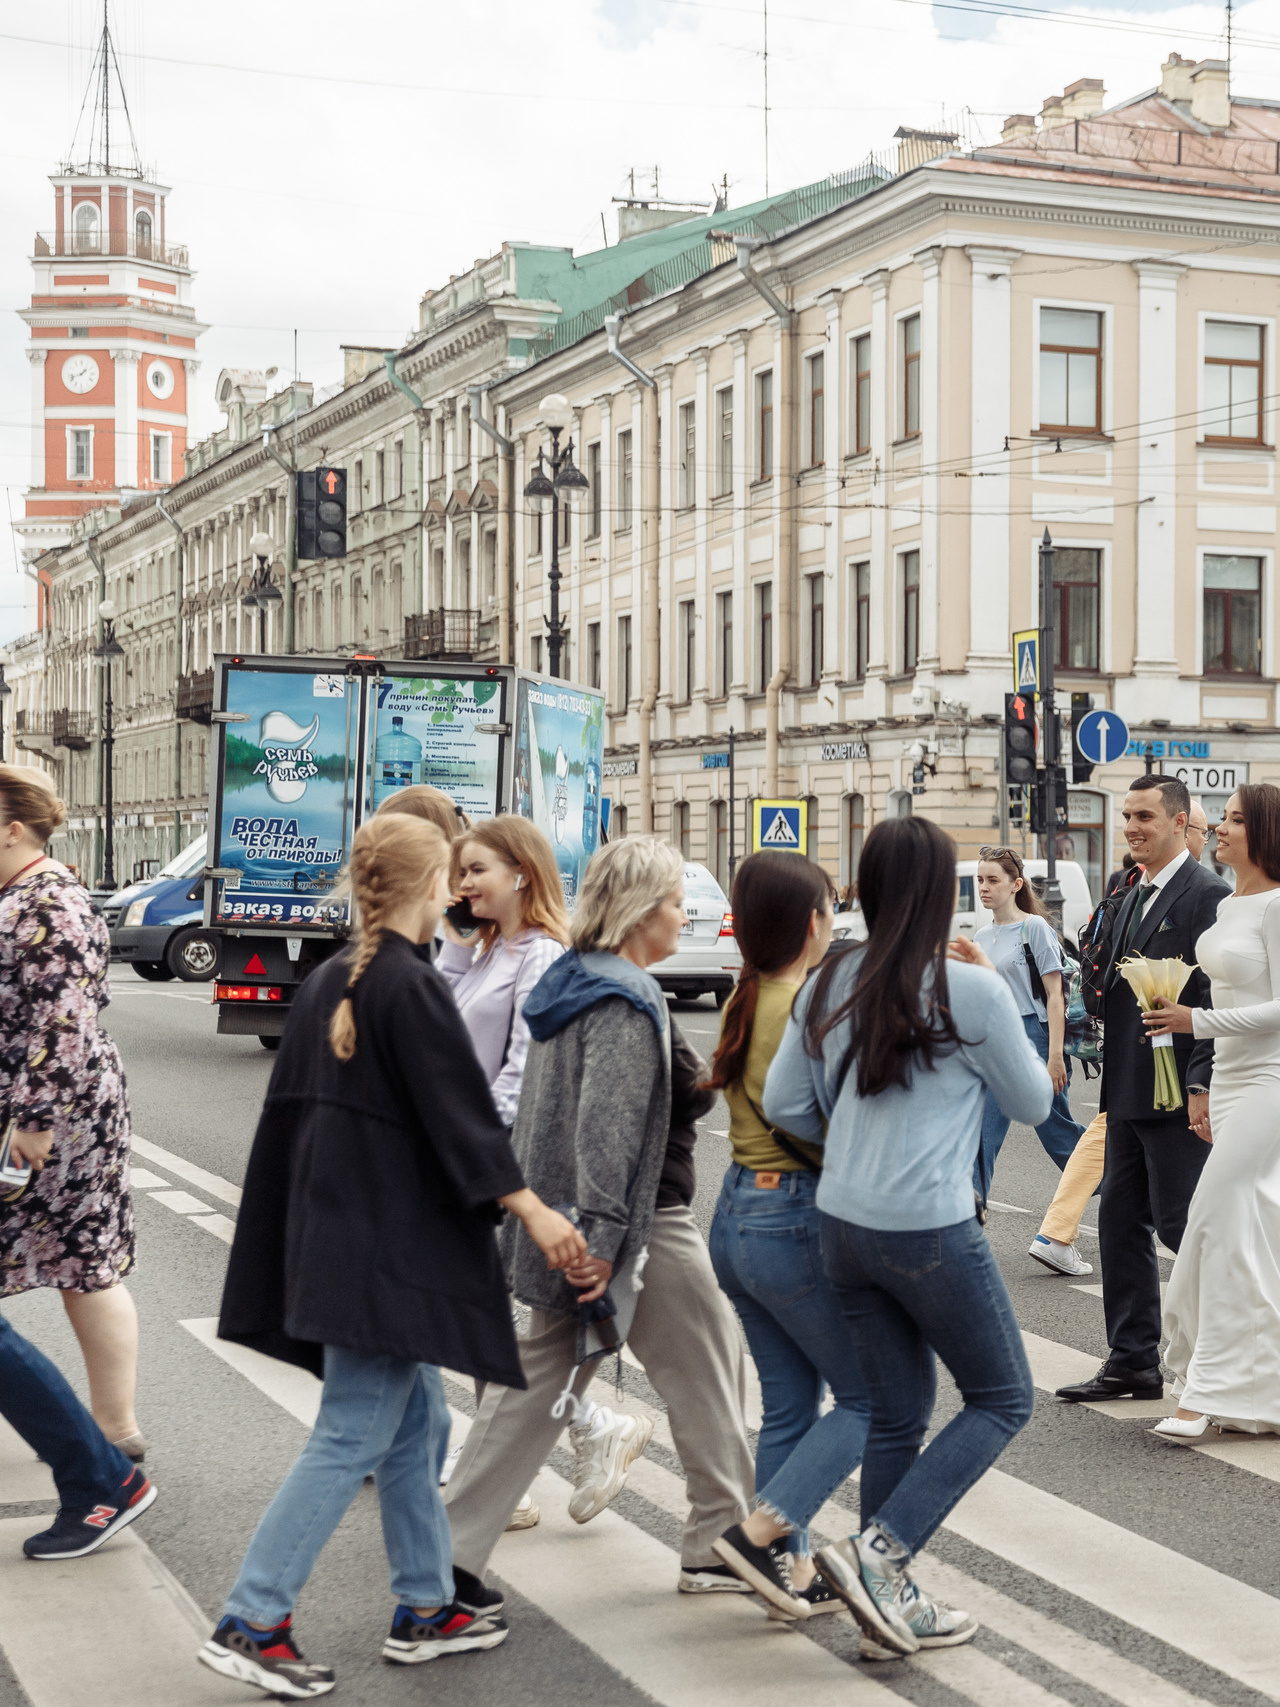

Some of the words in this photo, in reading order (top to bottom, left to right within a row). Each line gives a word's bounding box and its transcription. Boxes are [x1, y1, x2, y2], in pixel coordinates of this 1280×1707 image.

[371, 683, 394, 709] 7
[390, 693, 429, 702] причин
[431, 695, 479, 704] покупать
[388, 704, 413, 713] воду
[1169, 740, 1211, 758] ГОШ
[1175, 767, 1236, 788] СТОП
[230, 816, 299, 839] ВОДА
[238, 832, 319, 850] ЧЕСТНАЯ
[245, 848, 266, 860] ОТ
[267, 847, 344, 865] ПРИРОДЫ!
[223, 901, 284, 915] заказ
